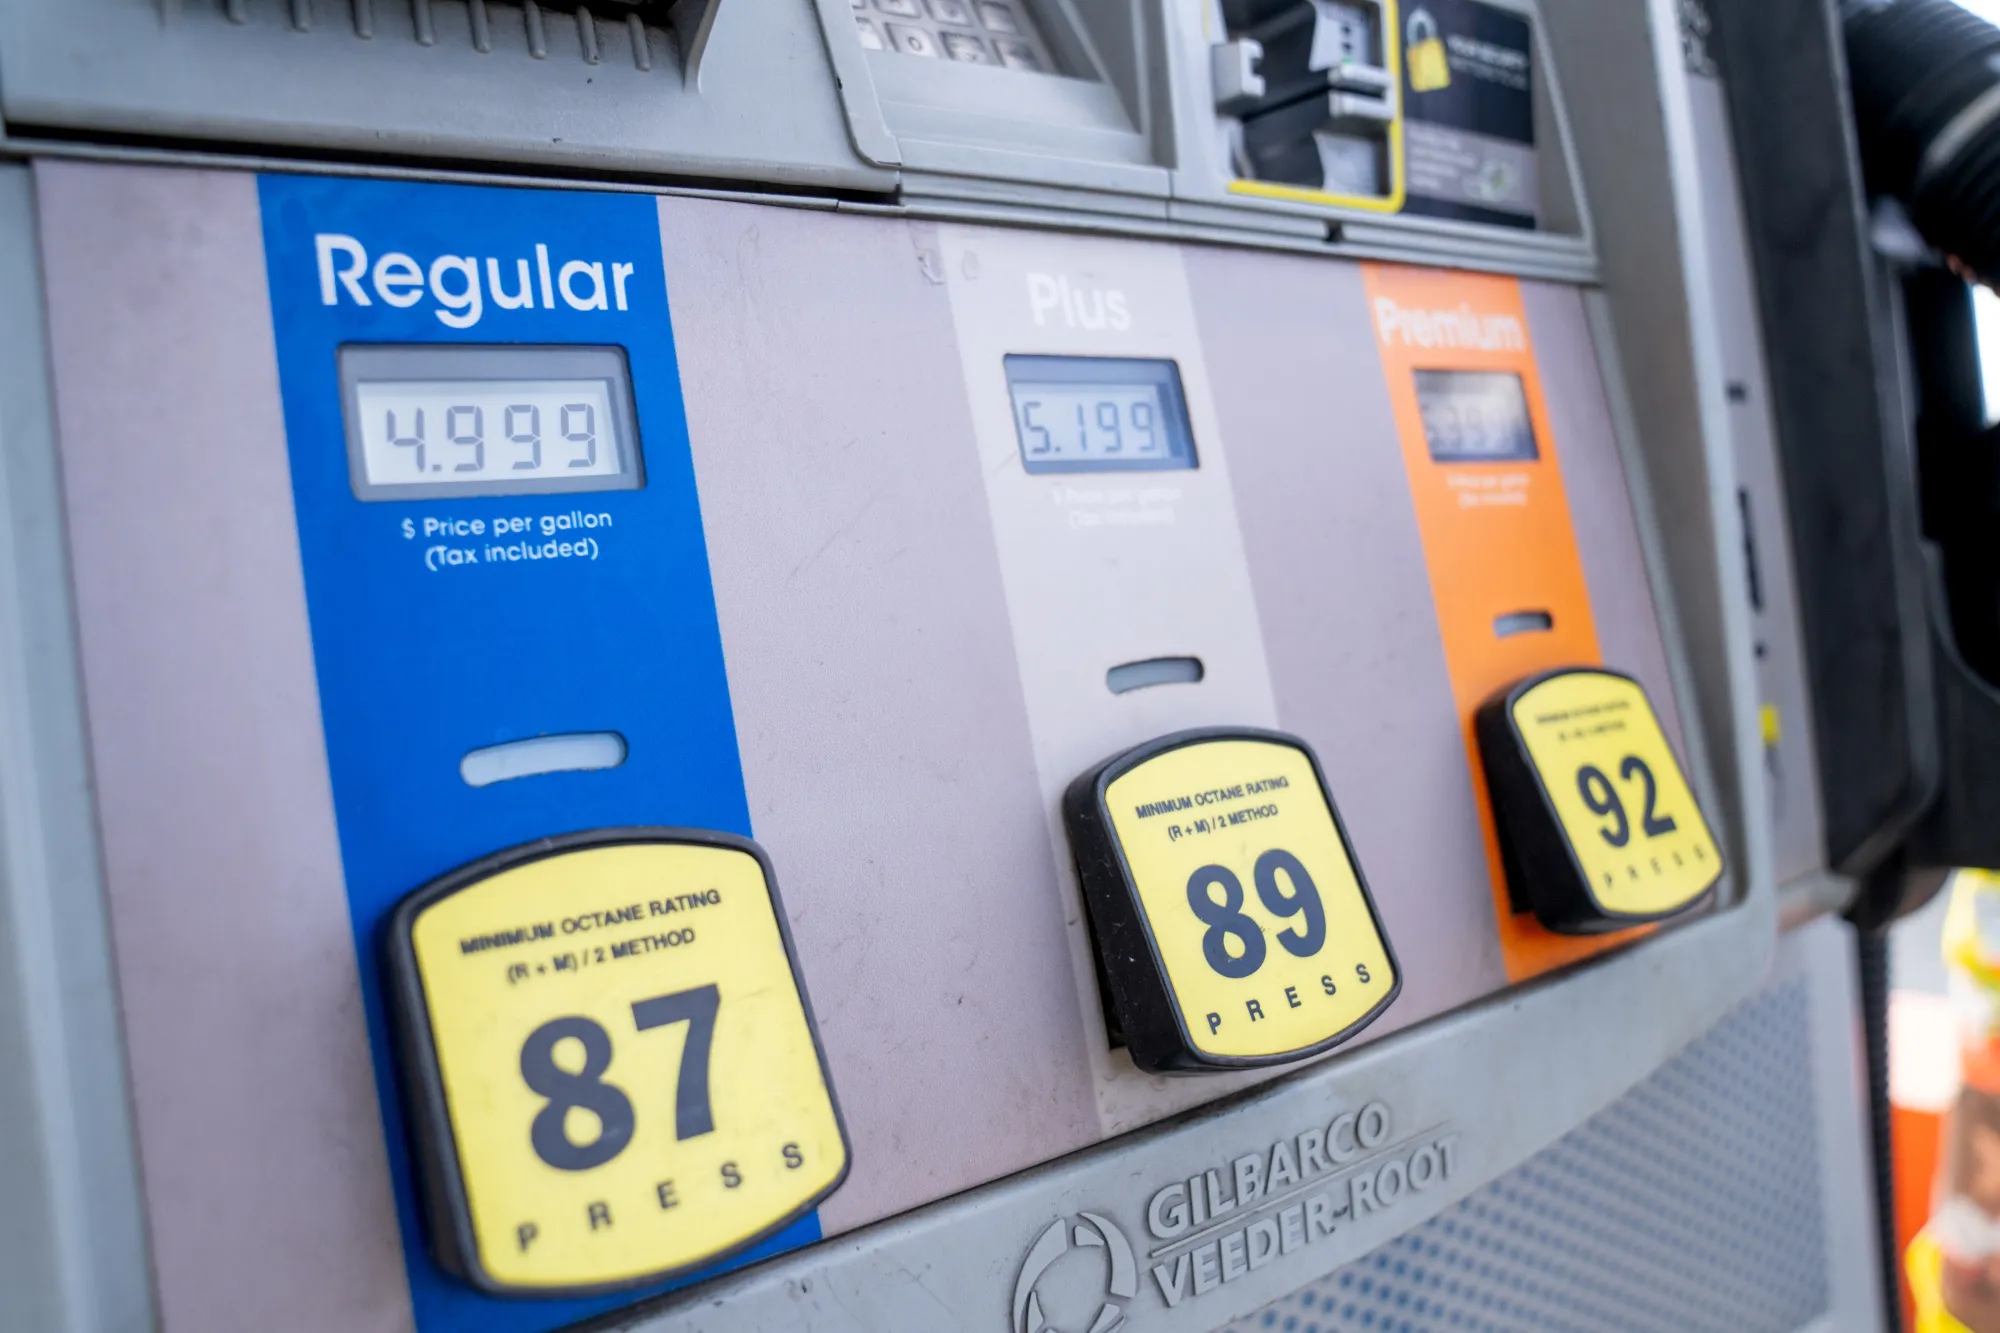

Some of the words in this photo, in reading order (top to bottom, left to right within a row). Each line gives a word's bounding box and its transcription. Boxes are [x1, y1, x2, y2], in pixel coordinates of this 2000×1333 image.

[314, 233, 635, 328] Regular
[1026, 272, 1131, 331] Plus
[1374, 296, 1526, 352] Premium
[386, 403, 597, 473] 4.999
[1023, 401, 1155, 454] 5.199
[402, 518, 415, 539] $
[424, 517, 485, 536] Price
[494, 515, 532, 536] per
[540, 510, 613, 536] gallon
[425, 545, 478, 571] (Tax
[485, 538, 598, 562] included)
[1135, 797, 1193, 819] MINIMUM
[1195, 785, 1245, 806] OCTANE
[1246, 776, 1289, 796] RATING
[1167, 826, 1183, 842] (R
[1195, 818, 1211, 834] M)
[1219, 815, 1227, 828] 2
[1229, 804, 1279, 827] METHOD
[1576, 753, 1677, 848] 92
[460, 921, 555, 955] MINIMUM
[561, 904, 644, 935] OCTANE
[649, 889, 722, 917] RATING
[1186, 847, 1327, 979] 89
[594, 947, 606, 963] 2
[611, 928, 695, 960] METHOD
[519, 982, 722, 1172] 87
[1147, 1101, 1390, 1240] GILBARCO
[1152, 1131, 1460, 1307] VEEDER-ROOT
